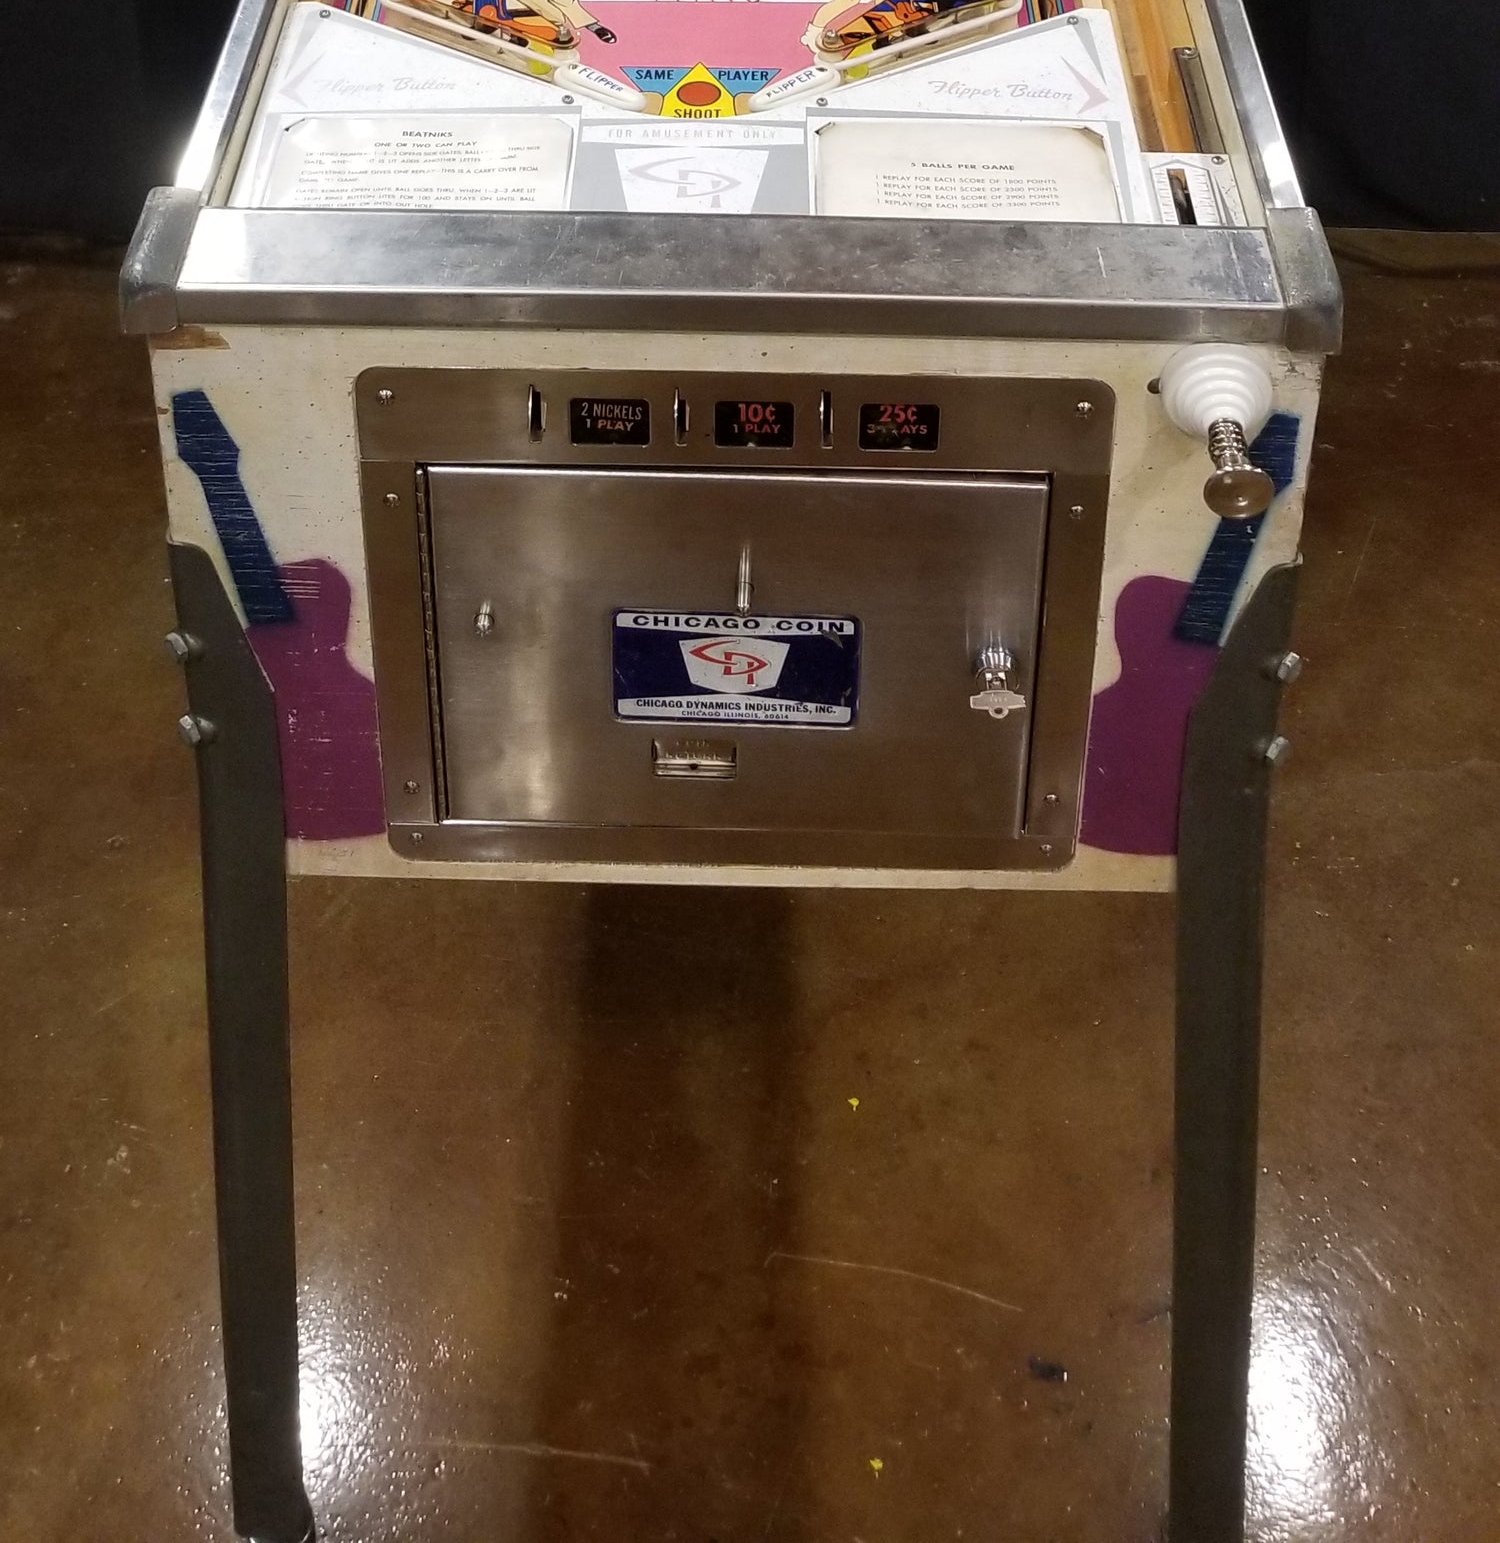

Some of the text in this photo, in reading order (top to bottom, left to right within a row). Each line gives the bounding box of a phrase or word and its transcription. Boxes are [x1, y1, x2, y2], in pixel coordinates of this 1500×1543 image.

[392, 76, 457, 91] Button
[577, 65, 624, 93] FLIPPER
[635, 69, 769, 81] SAME PLAYER
[765, 69, 816, 98] FLIPPER
[928, 80, 1073, 100] Flipper Button
[673, 108, 722, 119] SHOOT
[402, 130, 453, 138] BEATNIKS
[608, 128, 777, 139] FOR AMUSEMENT ONLY
[581, 402, 642, 420] 2 NICKELS
[737, 402, 776, 424] 10¢
[879, 404, 917, 424] 25¢
[585, 418, 634, 431] 1 PLAY
[732, 423, 781, 434] 1 PLAY
[632, 614, 845, 633] CHICAGO COIN
[636, 698, 837, 715] CHICAGO DYNAMICS INDUSTRIES, INC.
